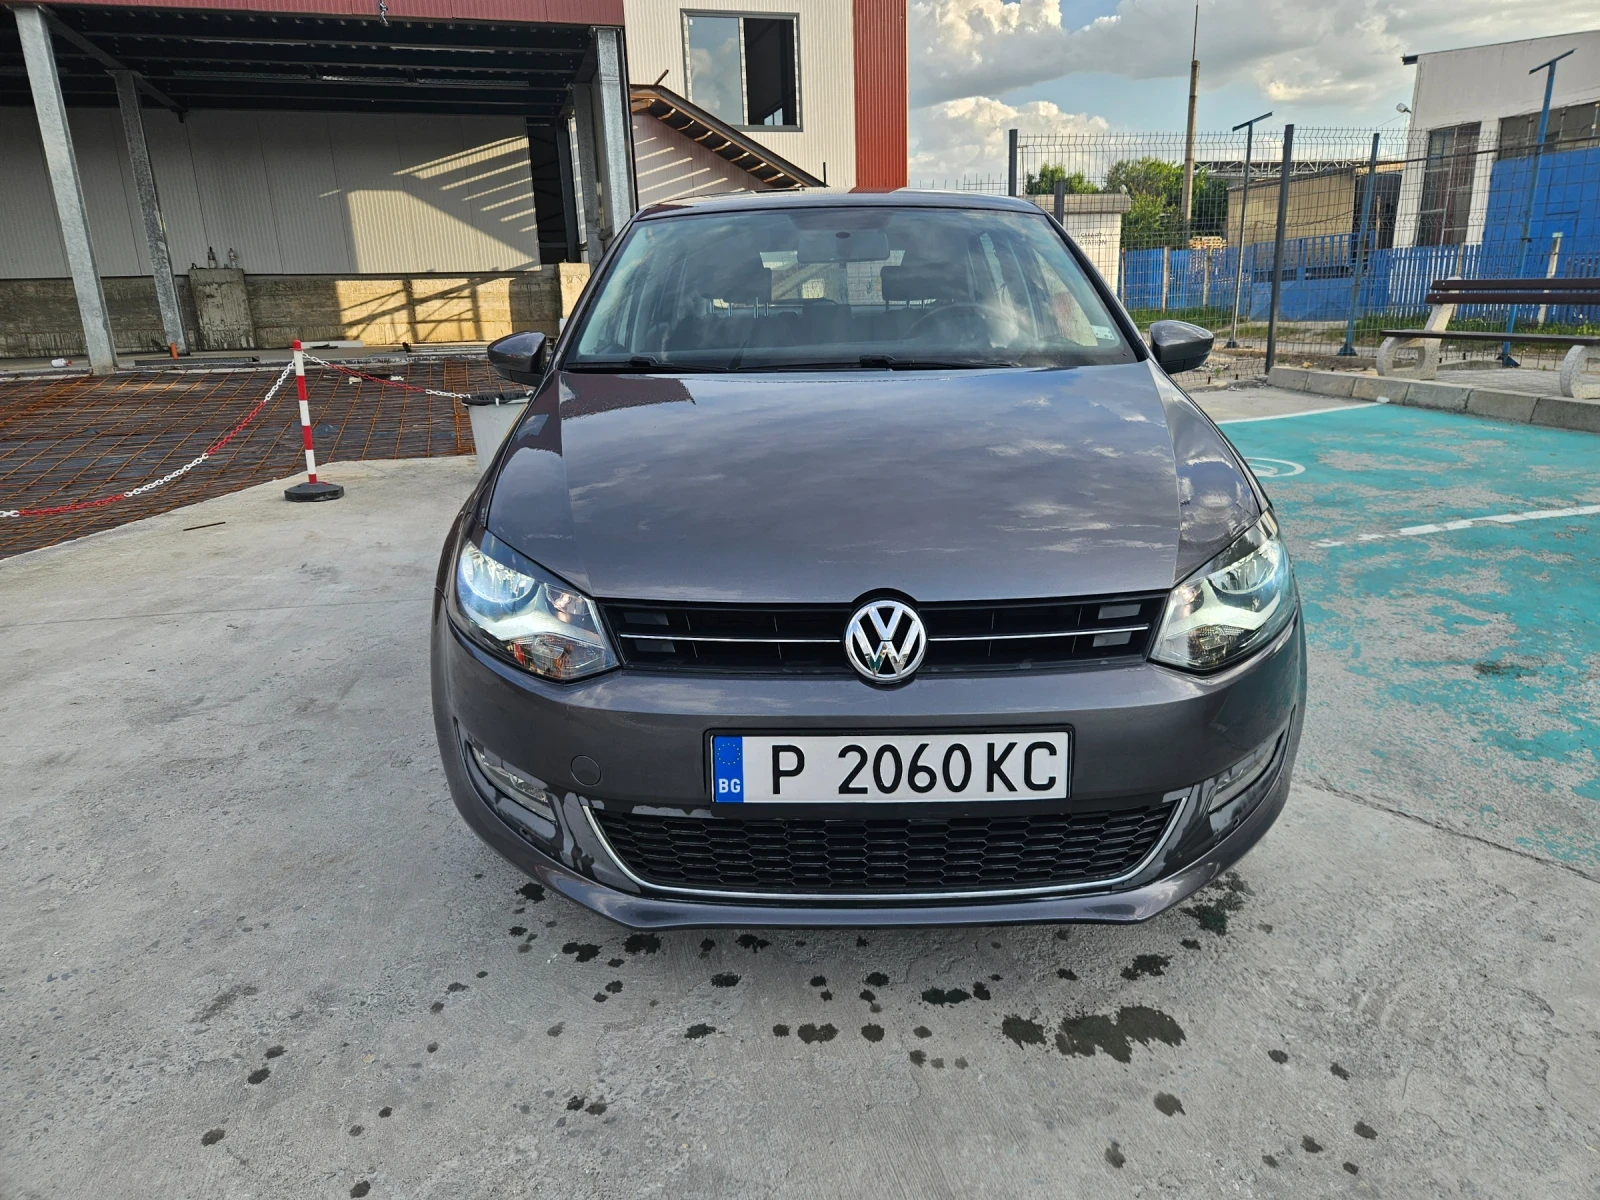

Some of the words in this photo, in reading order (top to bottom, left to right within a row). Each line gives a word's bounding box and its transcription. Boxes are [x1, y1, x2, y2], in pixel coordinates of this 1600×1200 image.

[771, 744, 806, 795] P
[837, 743, 973, 795] 2060
[986, 741, 1058, 793] KC
[718, 778, 741, 794] BG
